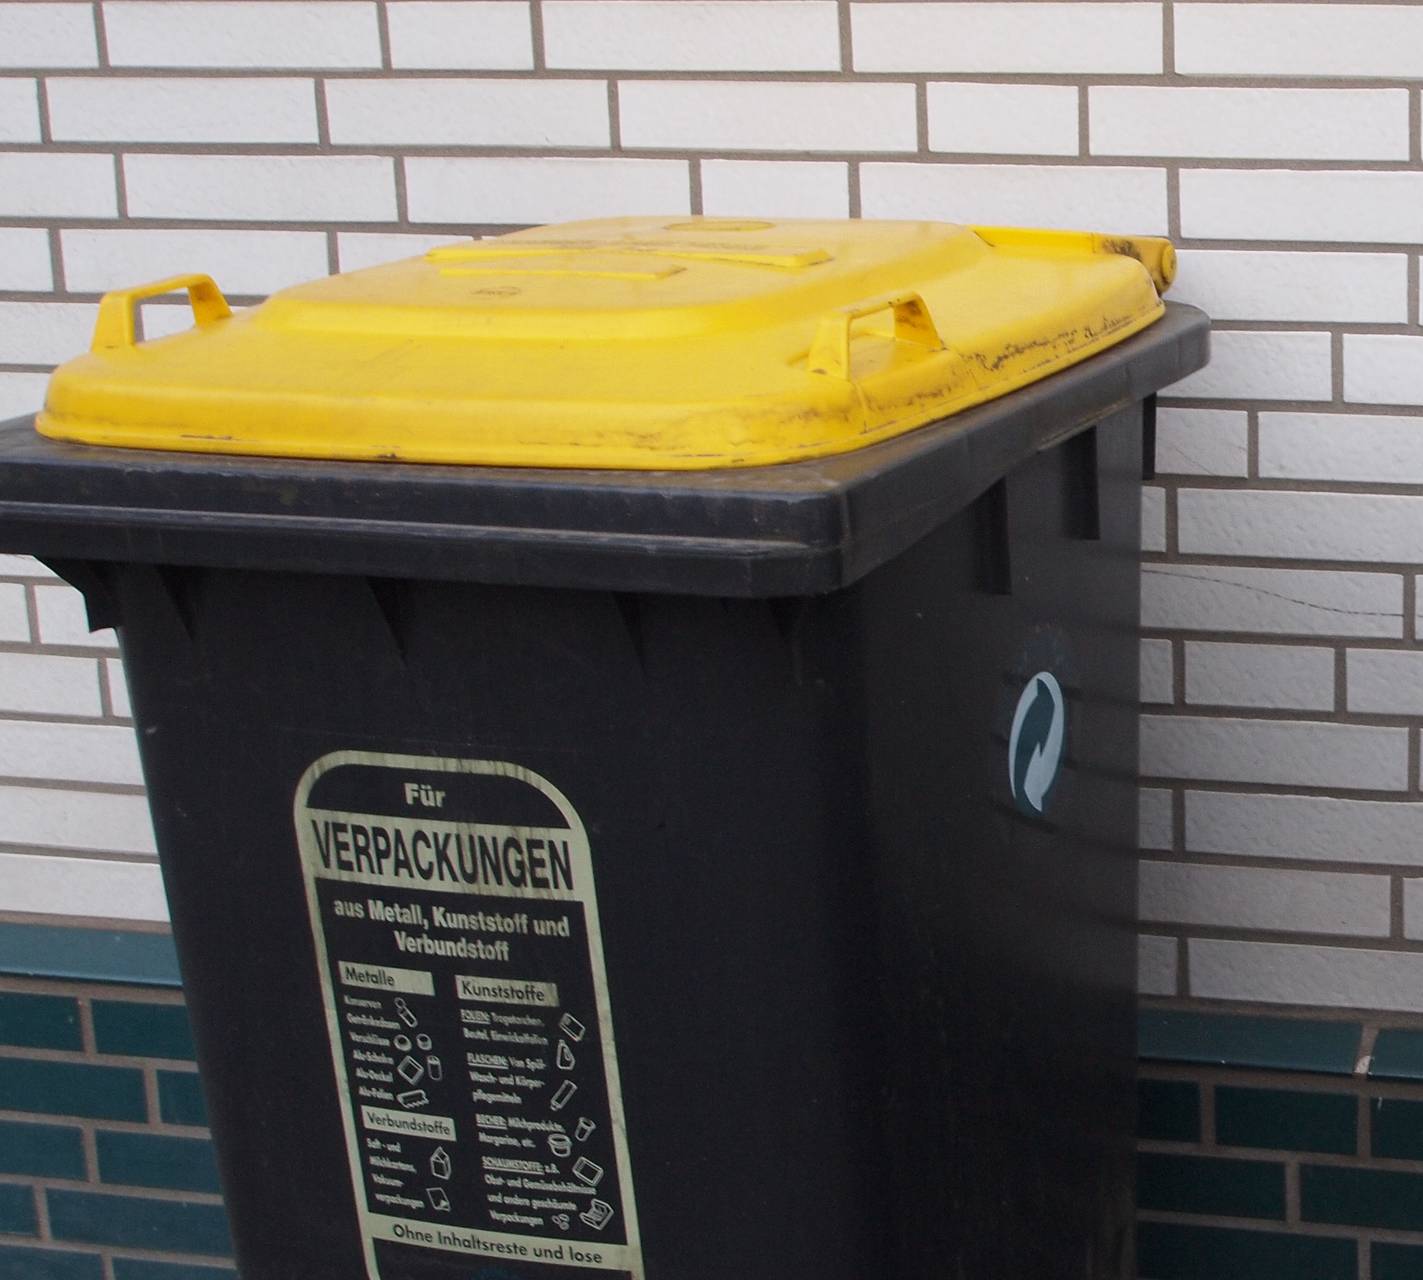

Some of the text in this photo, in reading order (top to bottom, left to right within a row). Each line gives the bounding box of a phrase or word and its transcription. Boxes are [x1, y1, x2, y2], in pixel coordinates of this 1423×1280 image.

[404, 782, 445, 807] Für
[312, 819, 574, 890] VERPACKUNGEN
[334, 899, 570, 937] aus Metall, Kunststoff und
[394, 931, 510, 961] Verbundstoff
[345, 966, 396, 986] Metalle
[461, 980, 545, 1001] Kunststoffe
[366, 1112, 451, 1135] Verbundstoffe
[392, 1223, 603, 1264] Ohne Inhaltsreste und lose
